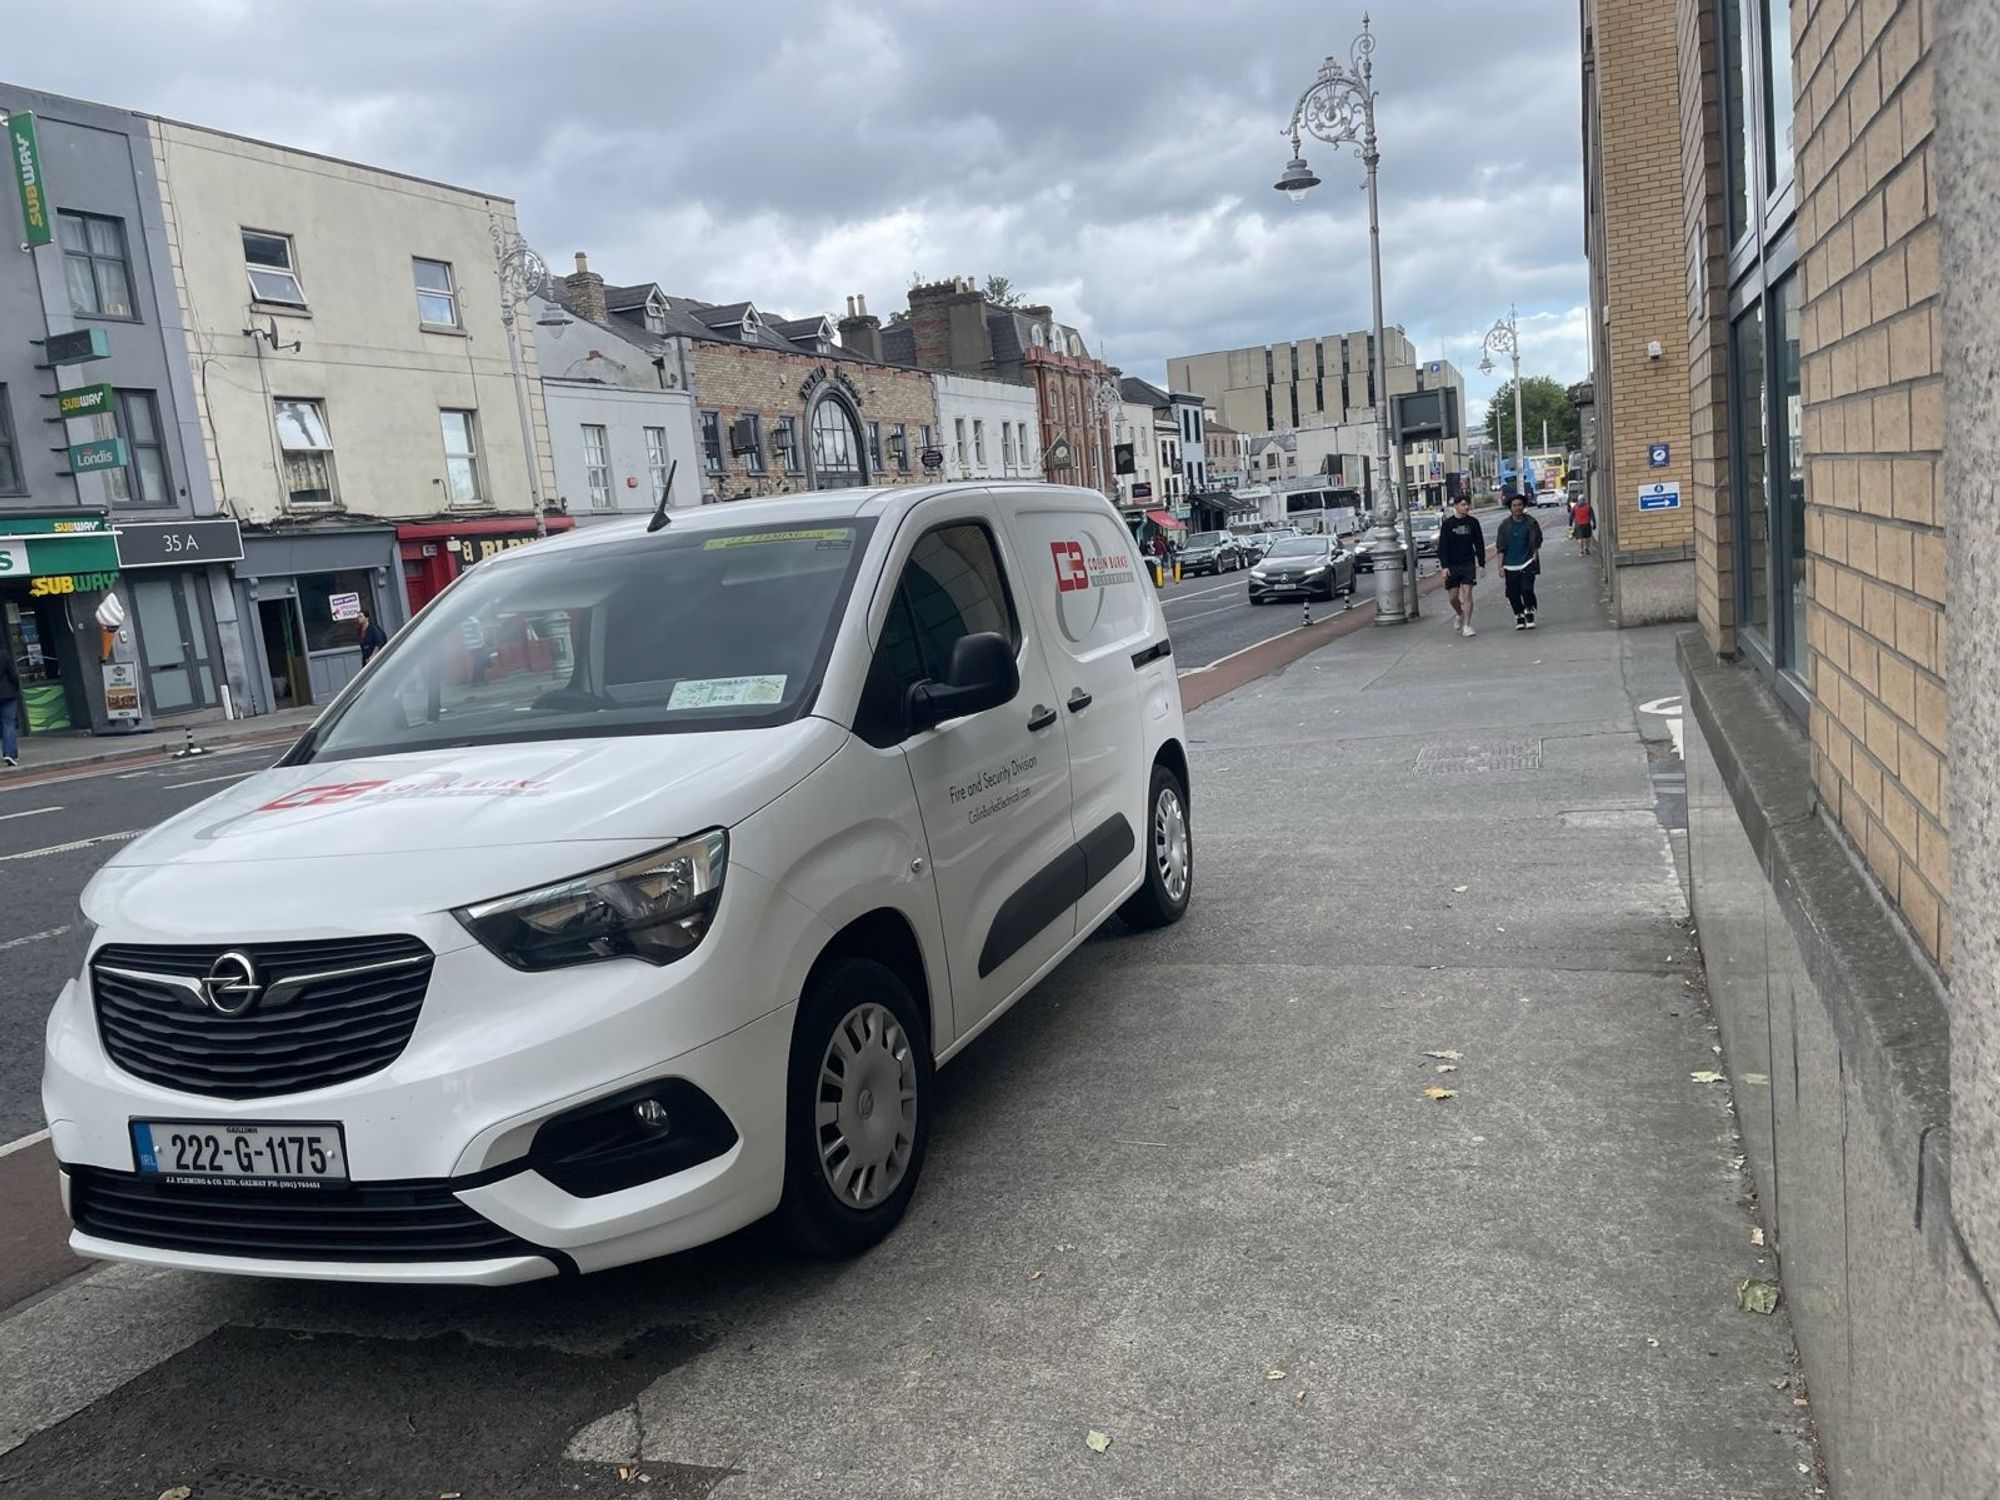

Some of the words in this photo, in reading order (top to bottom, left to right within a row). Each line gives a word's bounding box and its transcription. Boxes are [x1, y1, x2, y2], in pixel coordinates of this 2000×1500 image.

[16, 132, 43, 227] SUBWAY
[61, 391, 104, 411] SUBWAY
[77, 450, 113, 466] Londis
[53, 521, 99, 532] SUBWAY
[162, 534, 182, 552] 35
[186, 533, 199, 551] A
[29, 572, 119, 597] SUBWAY
[949, 784, 967, 805] Fire
[967, 772, 983, 797] and
[983, 766, 1011, 789] Security
[1011, 755, 1038, 777] Division
[140, 1154, 157, 1167] IRL
[171, 1134, 327, 1174] 222-G-1175
[176, 1177, 206, 1185] FLEMING
[240, 1179, 267, 1187] GALWAY
